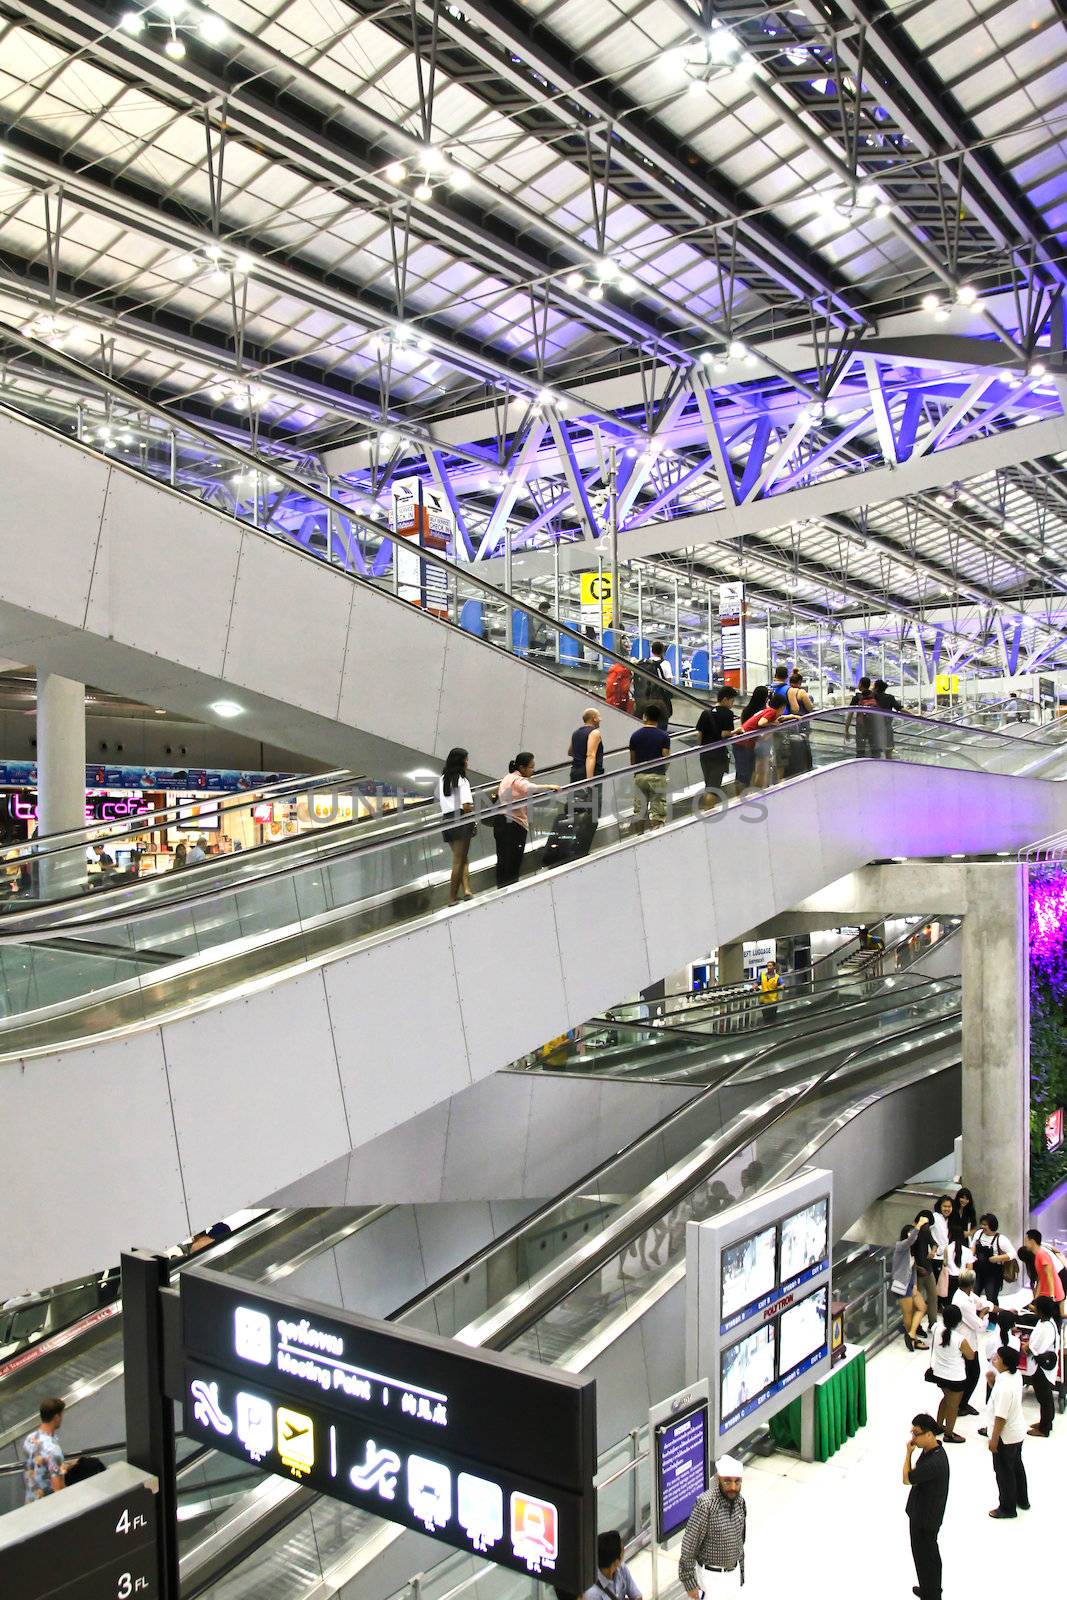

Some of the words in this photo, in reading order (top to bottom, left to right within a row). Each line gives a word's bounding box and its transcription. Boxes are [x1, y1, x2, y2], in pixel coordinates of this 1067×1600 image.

[590, 577, 611, 600] G
[942, 677, 951, 692] J
[752, 947, 772, 957] LUGGAGE
[763, 1293, 794, 1319] POLYTRON
[333, 1368, 371, 1401] Point
